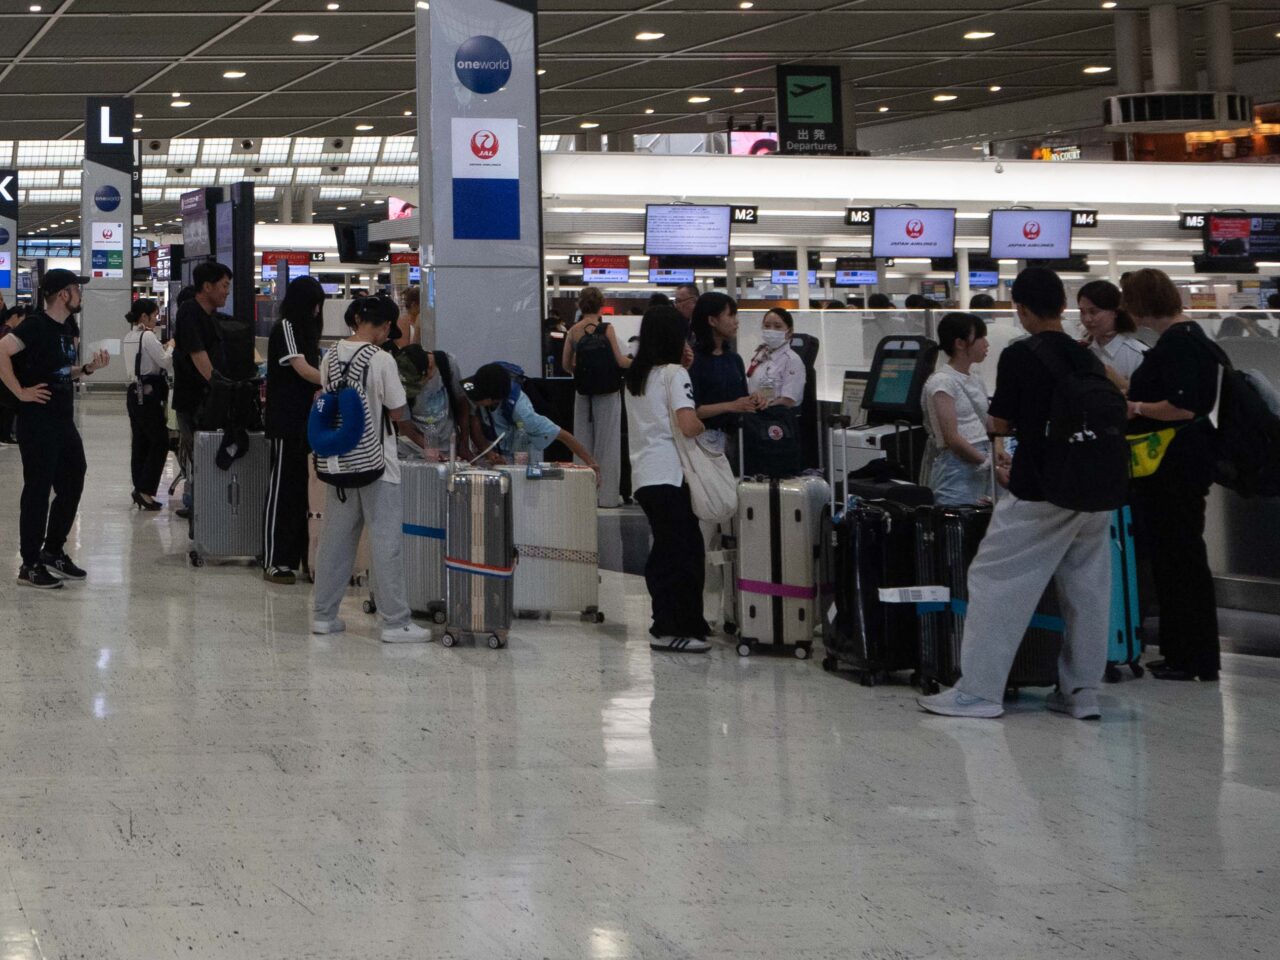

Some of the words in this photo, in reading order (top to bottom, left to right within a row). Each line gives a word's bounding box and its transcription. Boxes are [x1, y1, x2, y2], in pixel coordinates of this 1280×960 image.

[457, 59, 510, 70] oneworld
[100, 106, 123, 144] L
[797, 129, 825, 140] 出発
[786, 141, 838, 151] Departures
[479, 150, 494, 158] JAL
[735, 209, 754, 220] M2
[851, 211, 870, 222] M3
[1075, 213, 1094, 225] M4
[1186, 216, 1205, 227] M5
